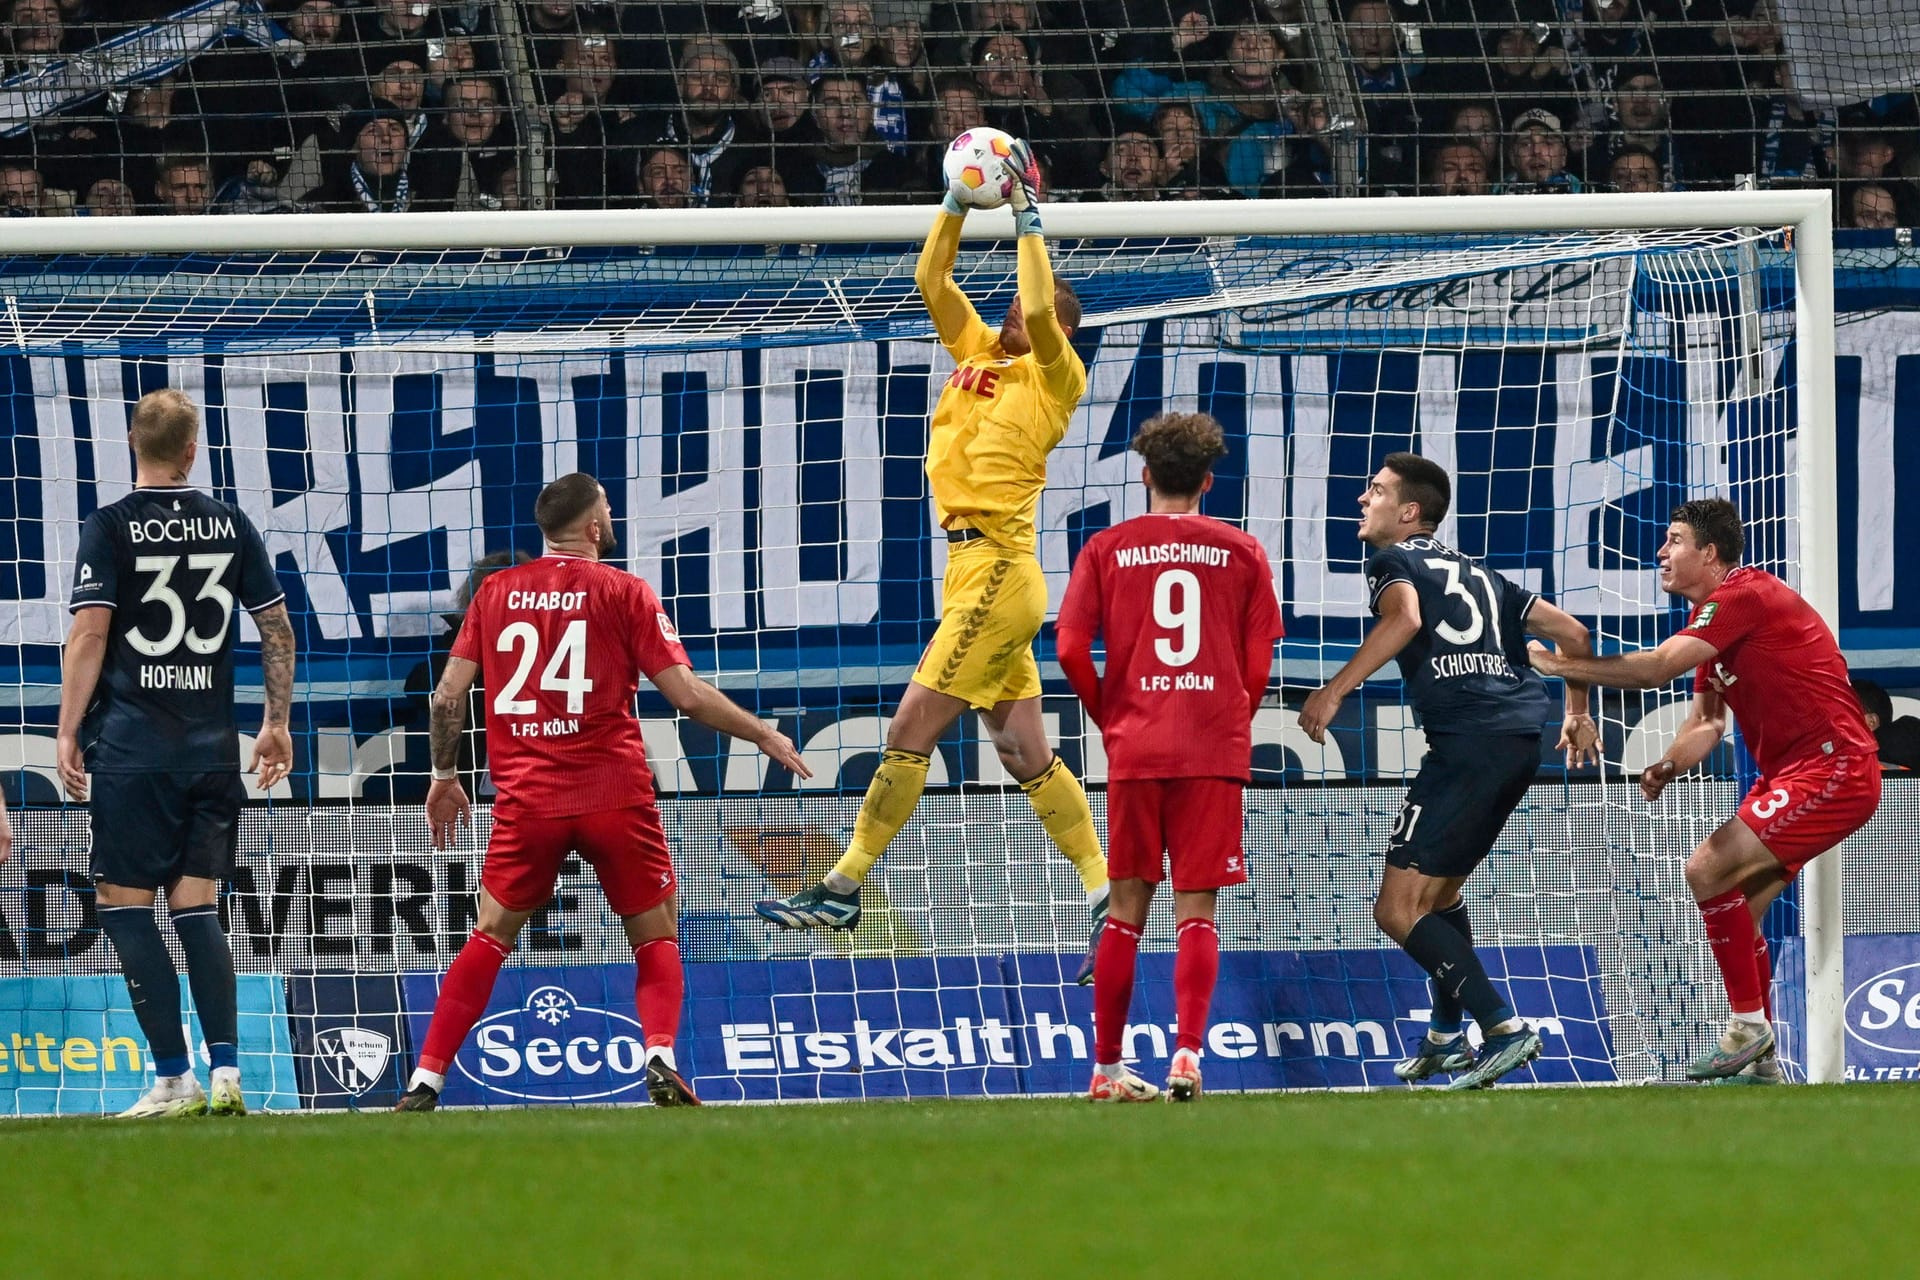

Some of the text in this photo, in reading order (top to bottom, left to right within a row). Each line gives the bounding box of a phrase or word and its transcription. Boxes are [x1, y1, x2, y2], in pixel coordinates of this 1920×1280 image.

[128, 516, 237, 544] BOCHUM
[1115, 542, 1231, 568] WALDSCHMIDT
[124, 552, 236, 657] 33
[507, 590, 588, 611] CHABOT
[1152, 568, 1201, 667] 9
[1423, 558, 1504, 652] 31
[493, 619, 594, 716] 24
[1175, 671, 1215, 692] KÖLN
[543, 717, 580, 737] KÖLN
[1751, 788, 1790, 819] 3
[476, 1024, 646, 1077] Seco
[721, 1016, 1016, 1071] Eiskalt
[1035, 1012, 1391, 1060] hnerm
